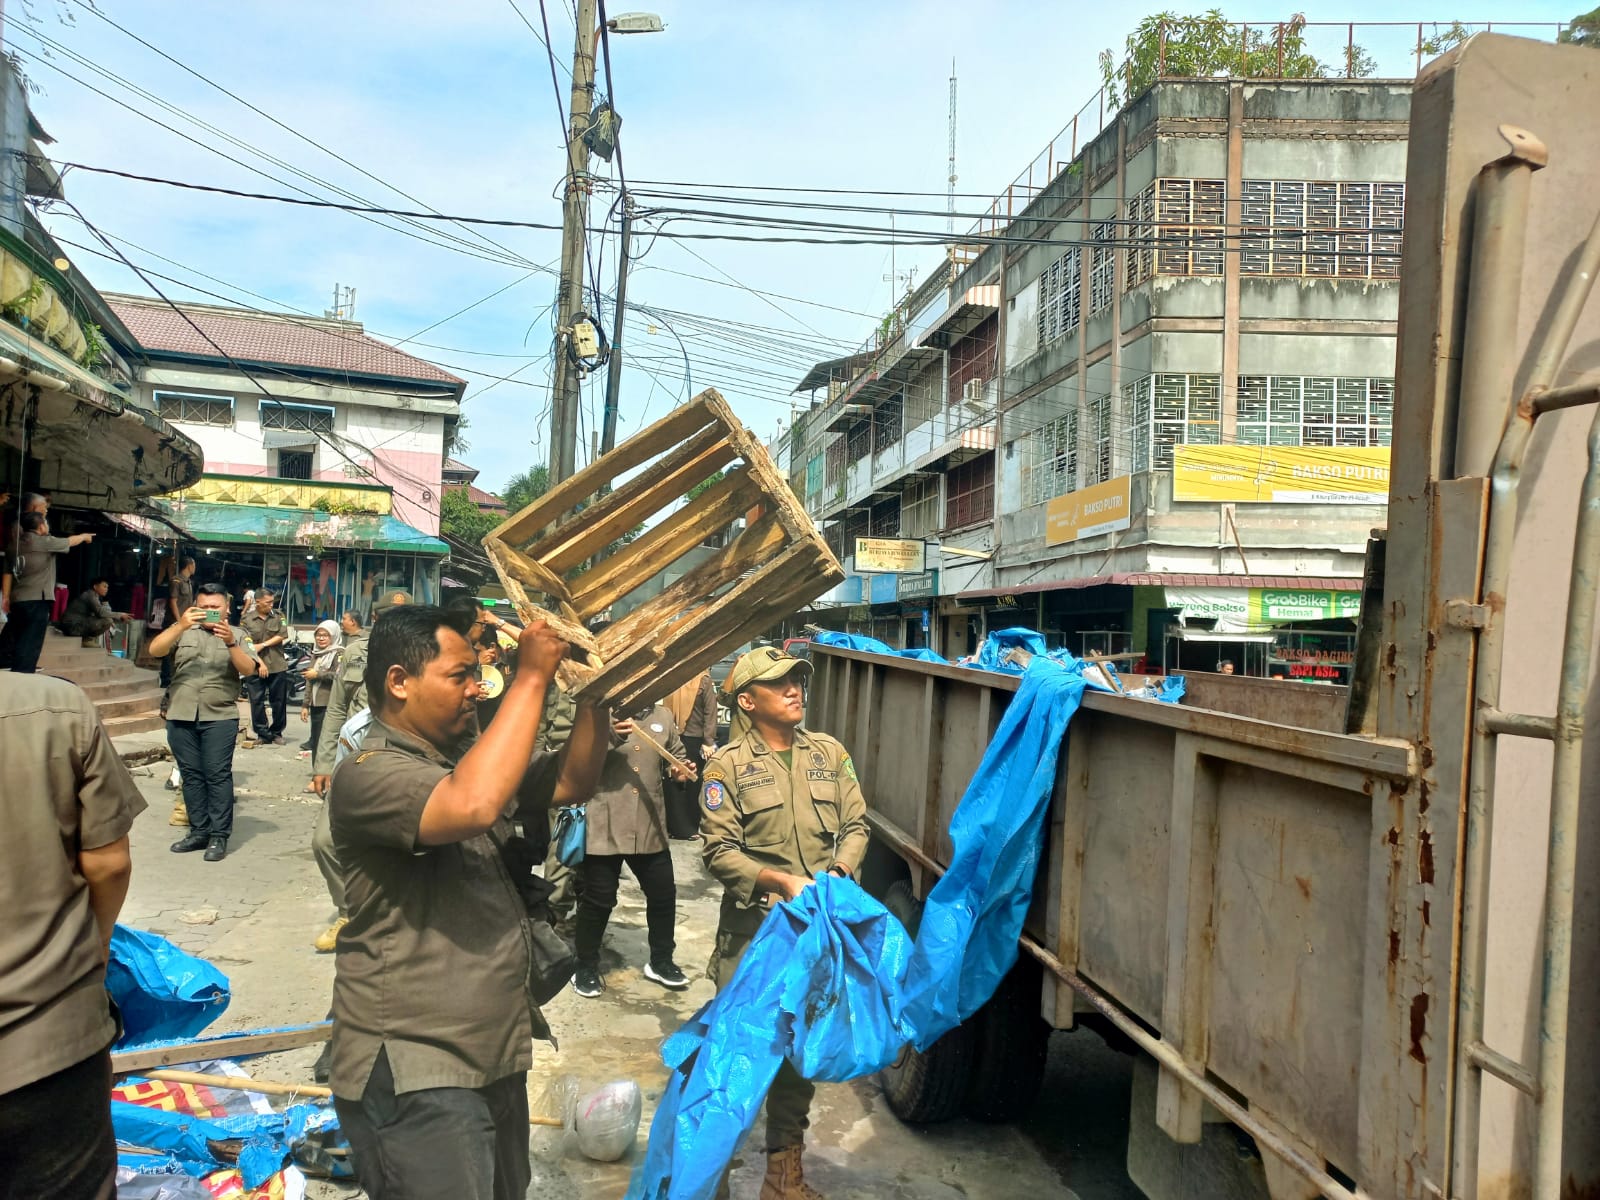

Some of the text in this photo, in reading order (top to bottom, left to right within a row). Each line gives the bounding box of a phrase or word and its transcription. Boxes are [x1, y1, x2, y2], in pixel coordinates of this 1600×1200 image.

[1292, 464, 1388, 480] BAKSO PUTRI
[1084, 495, 1123, 516] BAKSO PUTRI
[1264, 593, 1328, 607] GrabBike
[1212, 603, 1246, 613] Bakso
[1277, 608, 1314, 617] Hemat
[1289, 664, 1313, 676] SAPI
